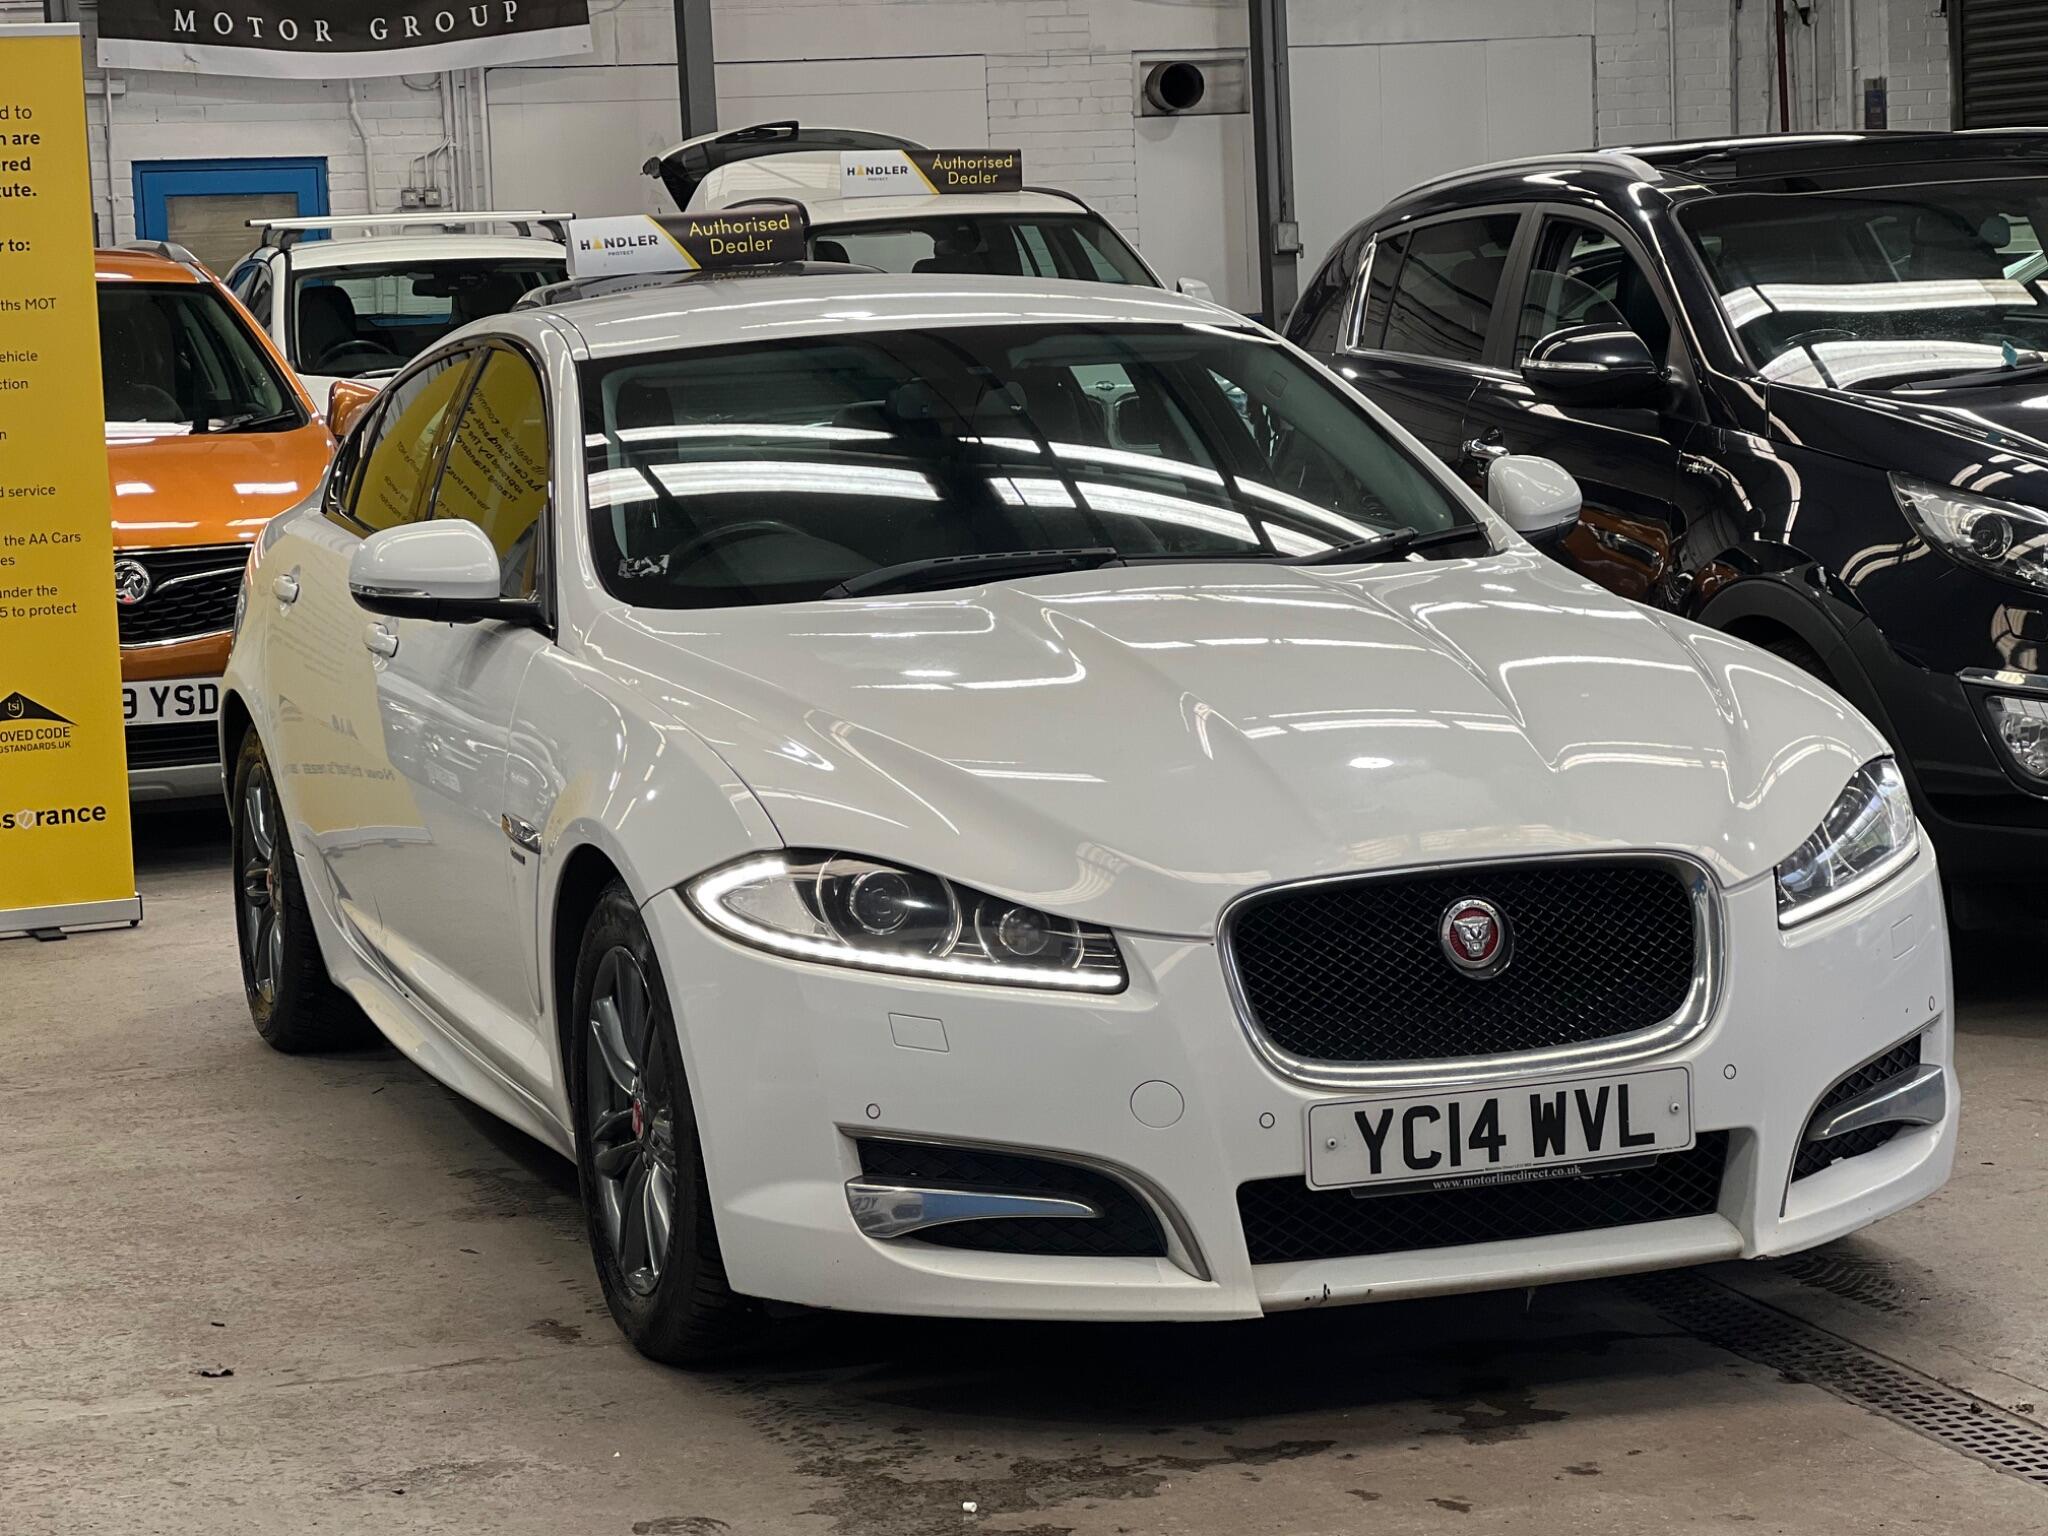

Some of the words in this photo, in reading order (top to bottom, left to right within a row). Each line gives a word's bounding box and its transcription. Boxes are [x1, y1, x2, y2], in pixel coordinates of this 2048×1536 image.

[174, 9, 333, 42] MOTOR
[369, 0, 518, 40] GROUP
[14, 105, 32, 120] to
[12, 133, 41, 146] are
[932, 154, 1013, 170] Authorised
[847, 165, 908, 176] HANDLER
[948, 171, 998, 185] Dealer
[689, 216, 791, 237] Authorised
[8, 238, 31, 252] to:
[580, 234, 659, 251] HANDLER
[710, 235, 773, 256] Dealer
[25, 297, 57, 311] MOT
[8, 485, 56, 498] service
[4, 534, 26, 547] the
[29, 532, 48, 545] AA
[51, 531, 82, 544] Cars
[36, 585, 58, 597] the
[12, 606, 26, 618] to
[29, 601, 78, 618] protect
[7, 699, 20, 712] tsi
[149, 683, 219, 718] YSD
[36, 726, 72, 740] CODE
[1354, 1098, 1508, 1176] YC14
[1529, 1083, 1656, 1158] WVL
[1432, 1164, 1583, 1191] www.motorlinedirect.co.uk
